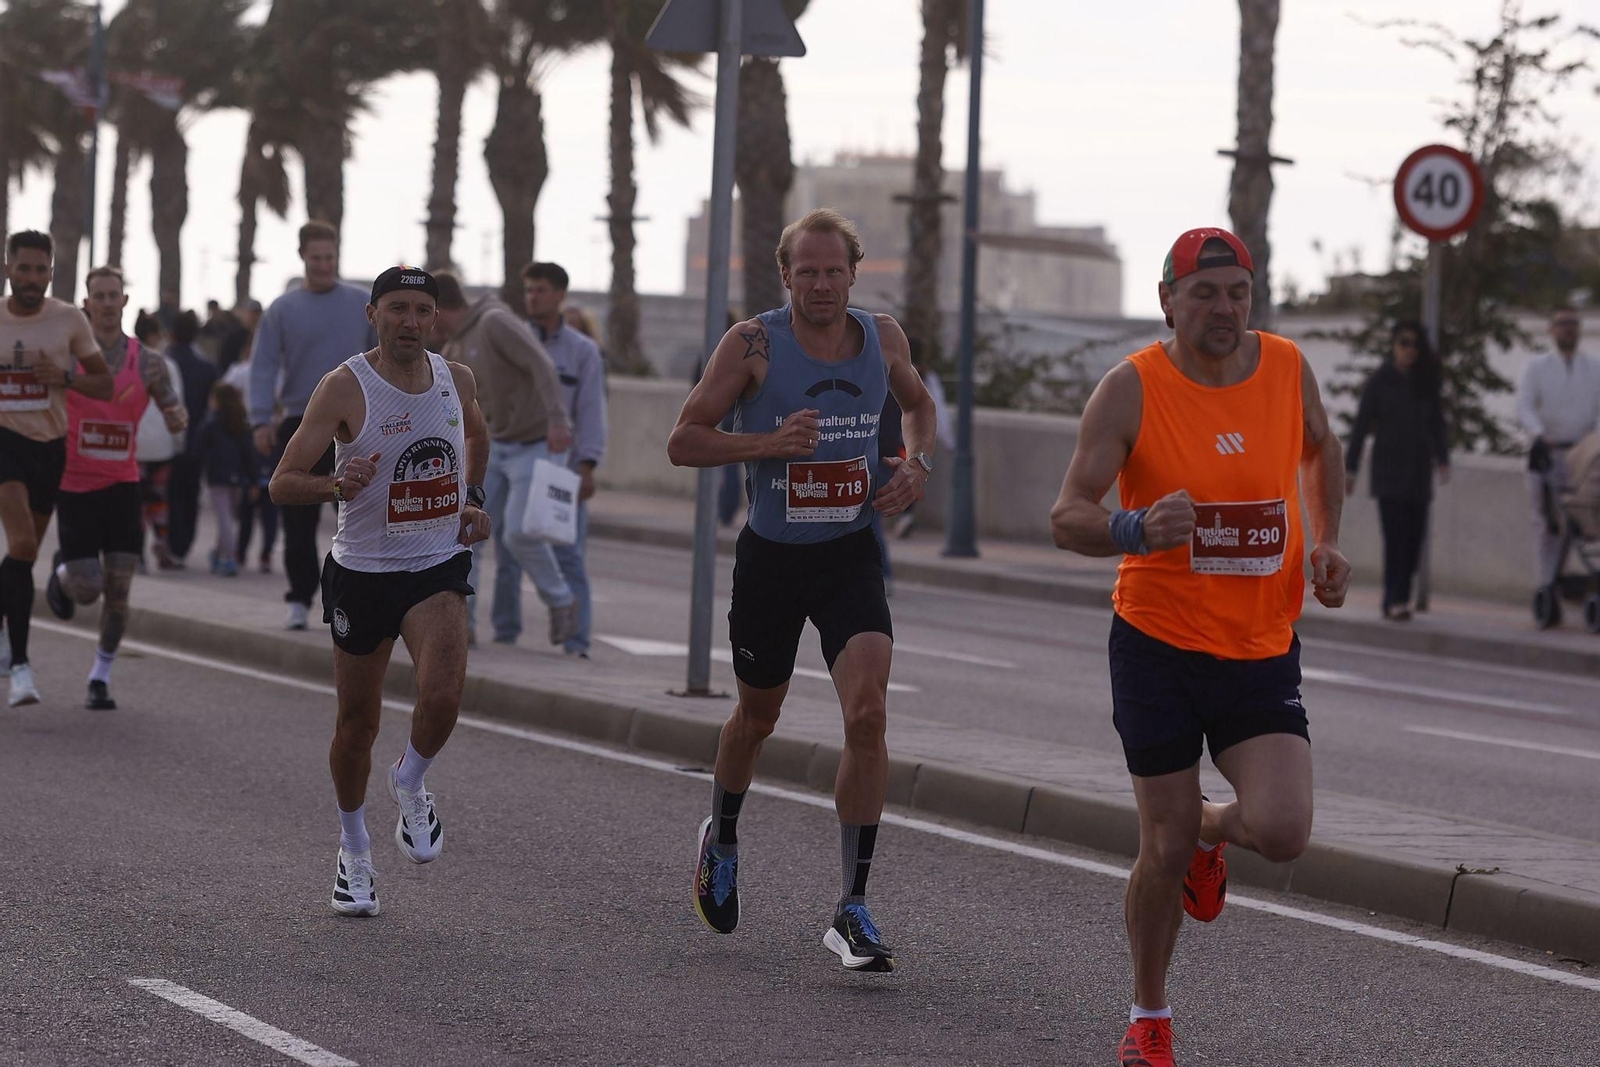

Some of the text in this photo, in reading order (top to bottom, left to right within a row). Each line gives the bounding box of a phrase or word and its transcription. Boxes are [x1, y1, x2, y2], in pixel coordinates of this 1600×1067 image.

[1412, 172, 1461, 209] 40
[400, 275, 426, 285] 226ERS
[379, 419, 412, 432] TALLERES
[382, 425, 412, 436] JUMA
[411, 439, 450, 454] RUNNING
[791, 481, 828, 492] BRUNCH
[834, 480, 863, 497] 718
[796, 489, 814, 499] RUN
[391, 497, 423, 508] BRUNCH
[425, 492, 458, 511] 1309
[394, 505, 410, 514] RUN
[1196, 527, 1240, 538] BRUNCH
[1247, 526, 1280, 546] 290
[1200, 536, 1222, 548] RUN
